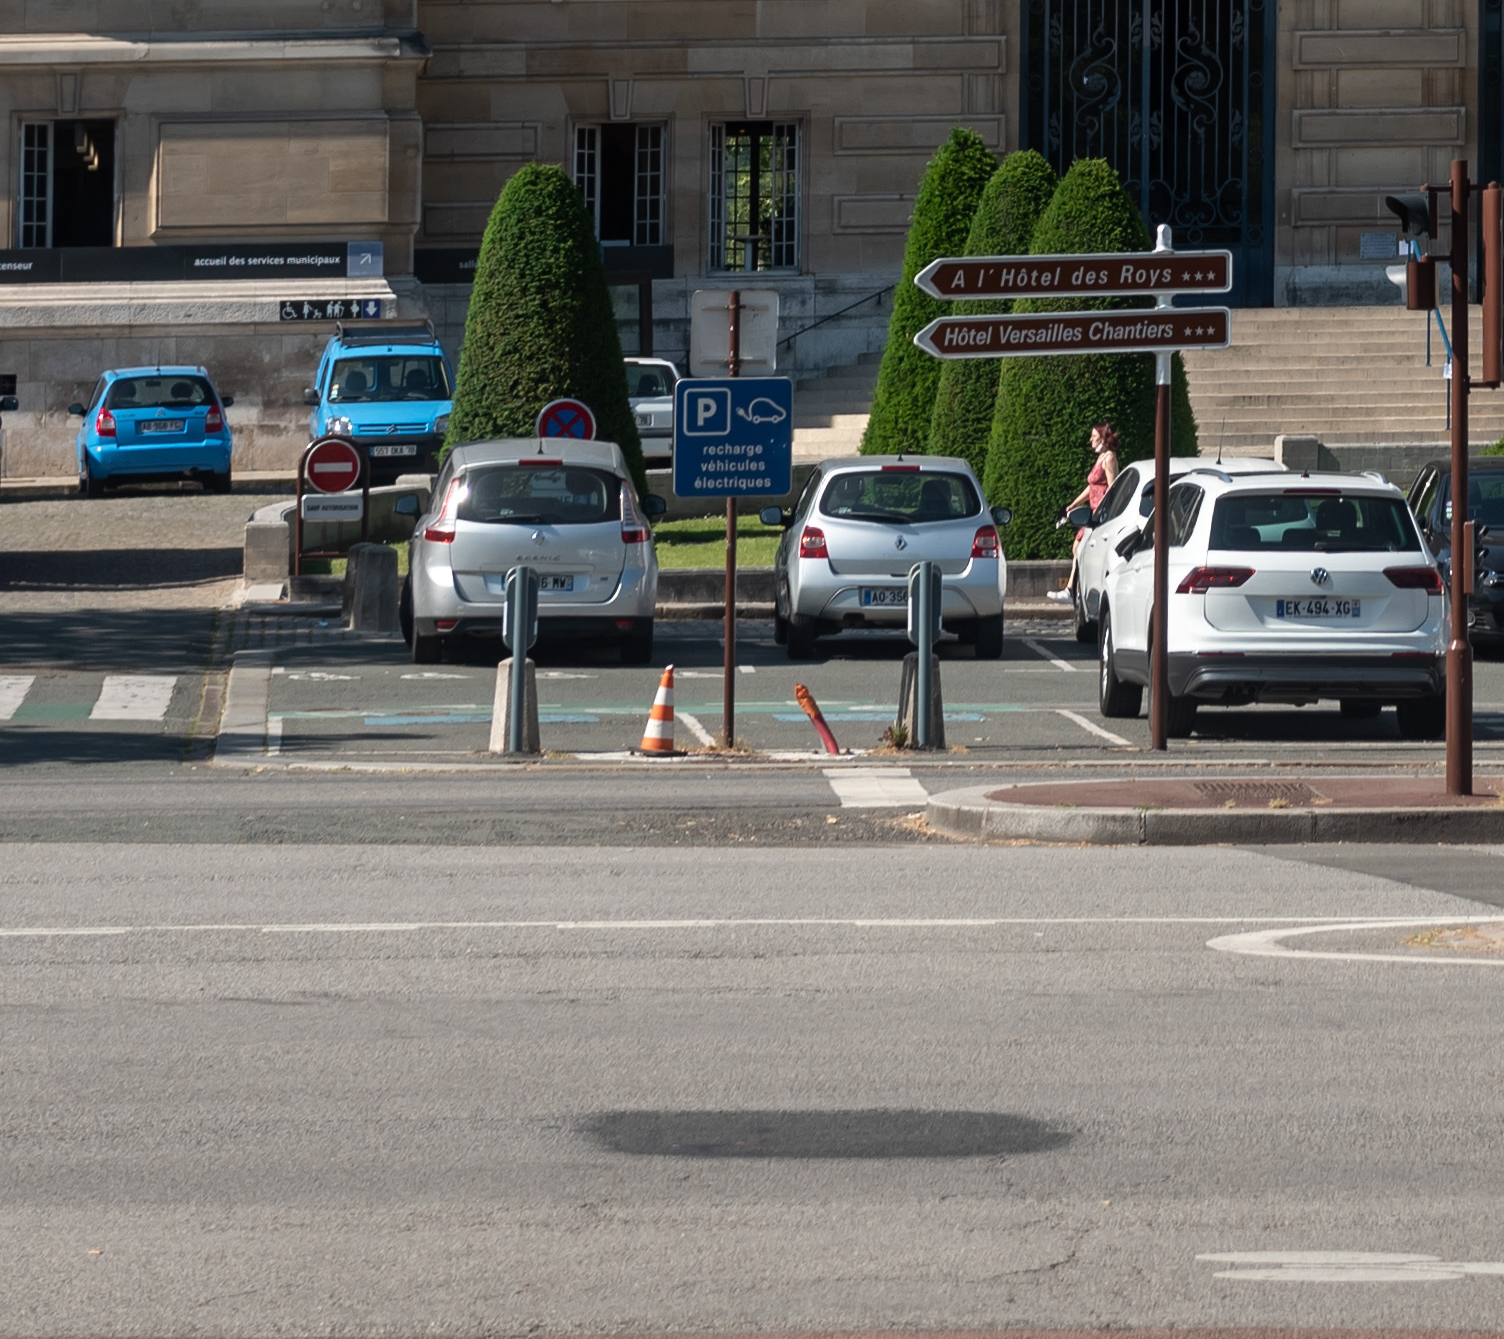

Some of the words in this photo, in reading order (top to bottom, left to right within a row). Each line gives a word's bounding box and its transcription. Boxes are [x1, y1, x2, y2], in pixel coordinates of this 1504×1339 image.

[194, 256, 227, 266] accueil
[229, 256, 245, 265] des
[248, 255, 284, 265] services
[287, 255, 340, 266] municipaux
[951, 270, 965, 288] A
[1071, 267, 1108, 285] des
[1120, 264, 1172, 287] Roys
[944, 326, 992, 347] Hôtel
[999, 323, 1082, 343] Versailles
[1088, 320, 1173, 341] Chantiers
[697, 398, 717, 426] P
[703, 443, 763, 457] recharge
[701, 459, 765, 472] véhicules
[694, 475, 771, 490] électriques
